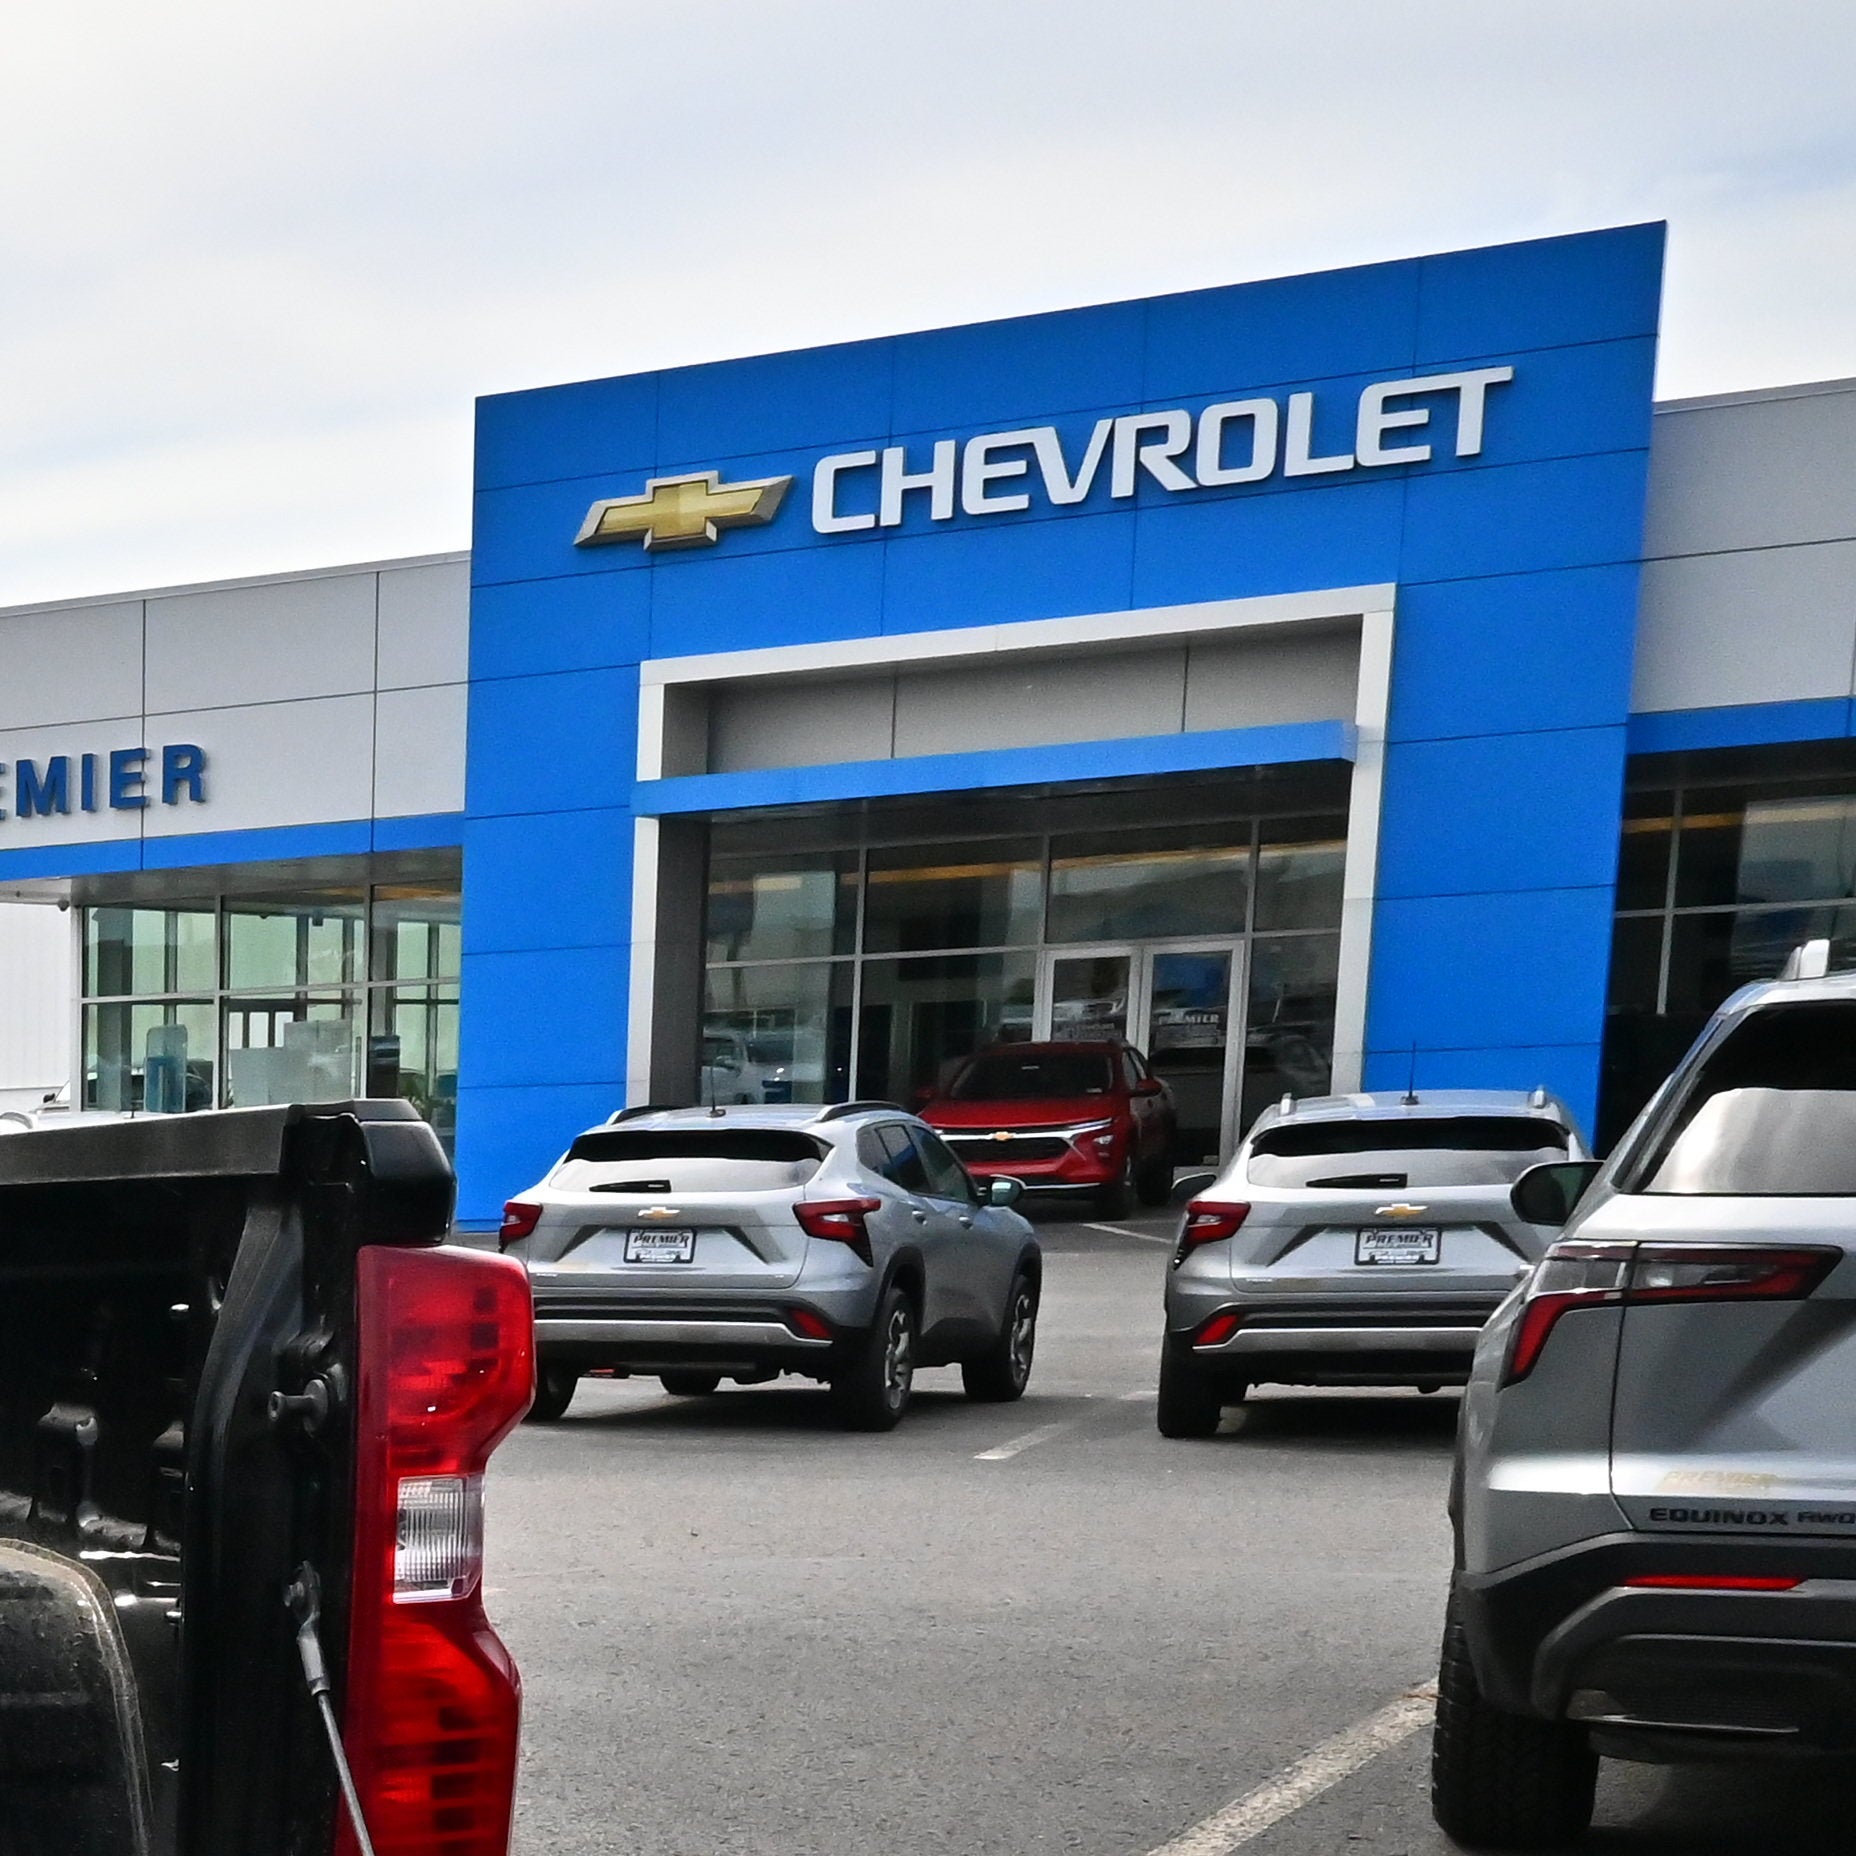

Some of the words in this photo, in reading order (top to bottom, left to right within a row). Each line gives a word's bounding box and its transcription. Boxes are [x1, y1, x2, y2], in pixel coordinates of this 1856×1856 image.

[812, 365, 1514, 535] CHEVROLET
[633, 1234, 690, 1248] PREMIER
[1366, 1233, 1434, 1248] PREMIER
[1649, 1507, 1789, 1526] EQUINOX
